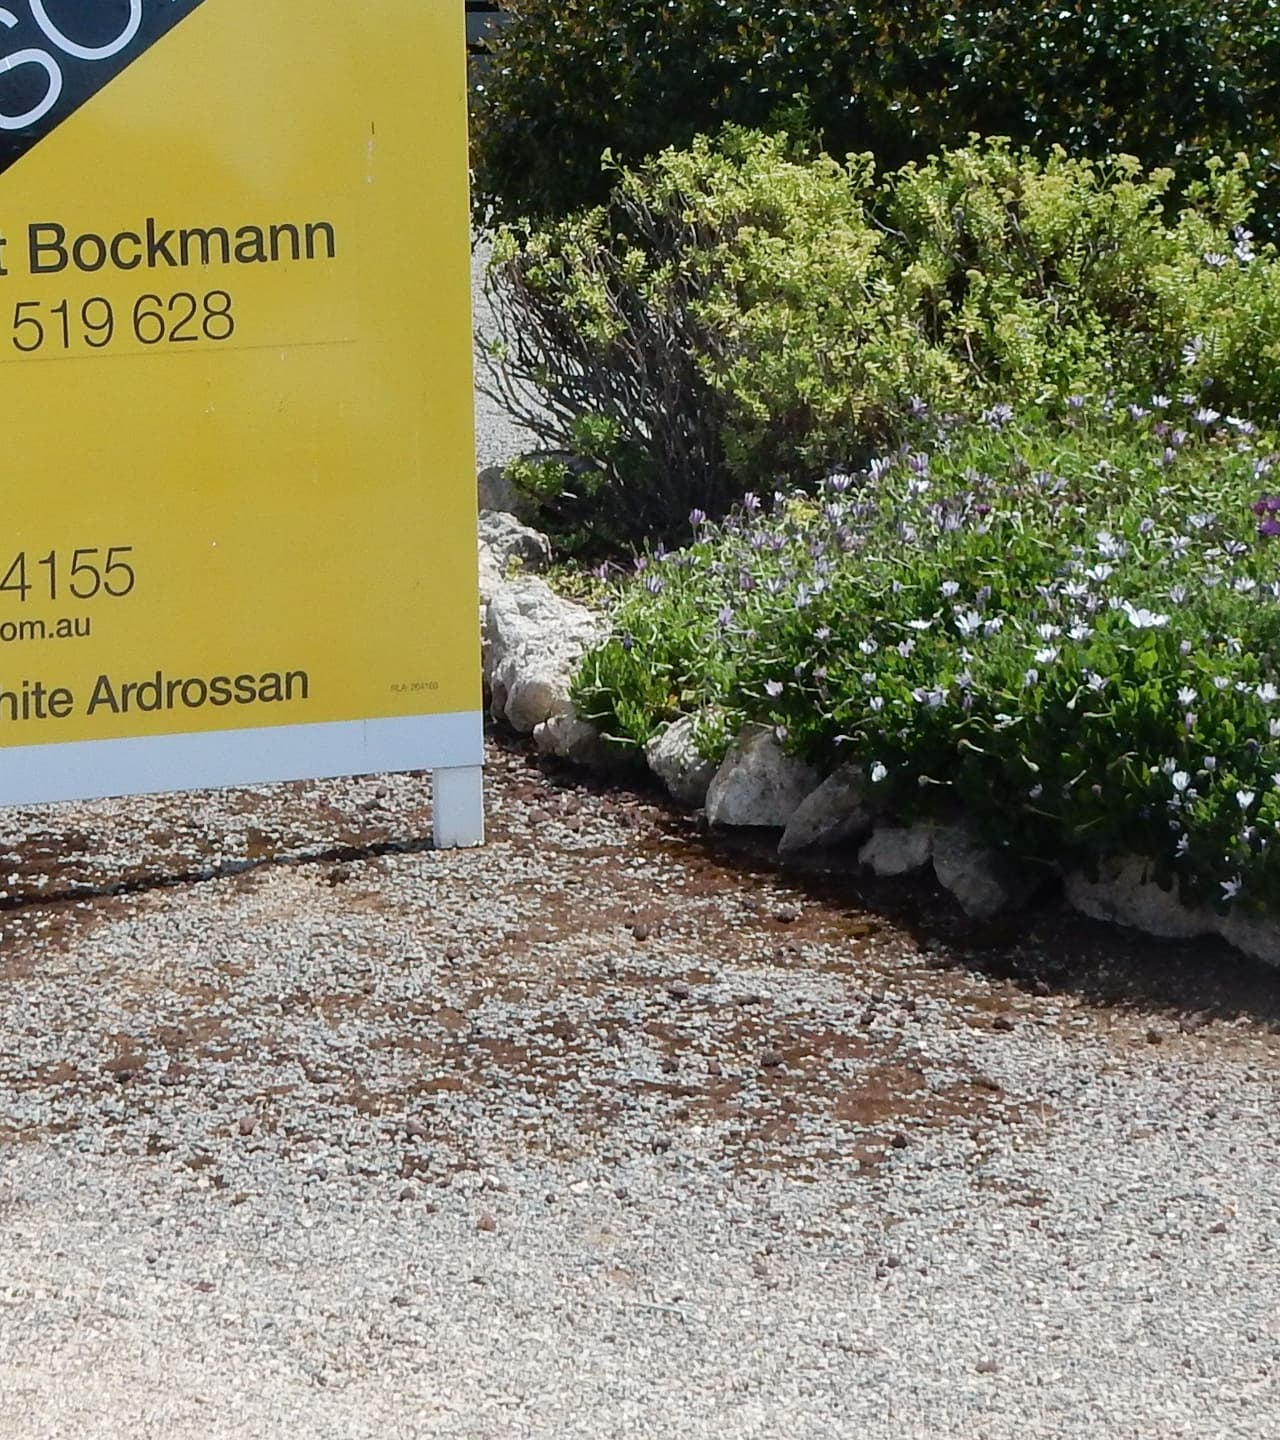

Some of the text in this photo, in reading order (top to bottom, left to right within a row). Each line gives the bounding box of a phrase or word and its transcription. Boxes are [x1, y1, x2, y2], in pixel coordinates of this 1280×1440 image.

[28, 217, 336, 275] Bockmann
[12, 296, 114, 352] 519
[133, 289, 235, 345] 628
[0, 546, 135, 602] 4155
[86, 669, 309, 716] Ardrossan
